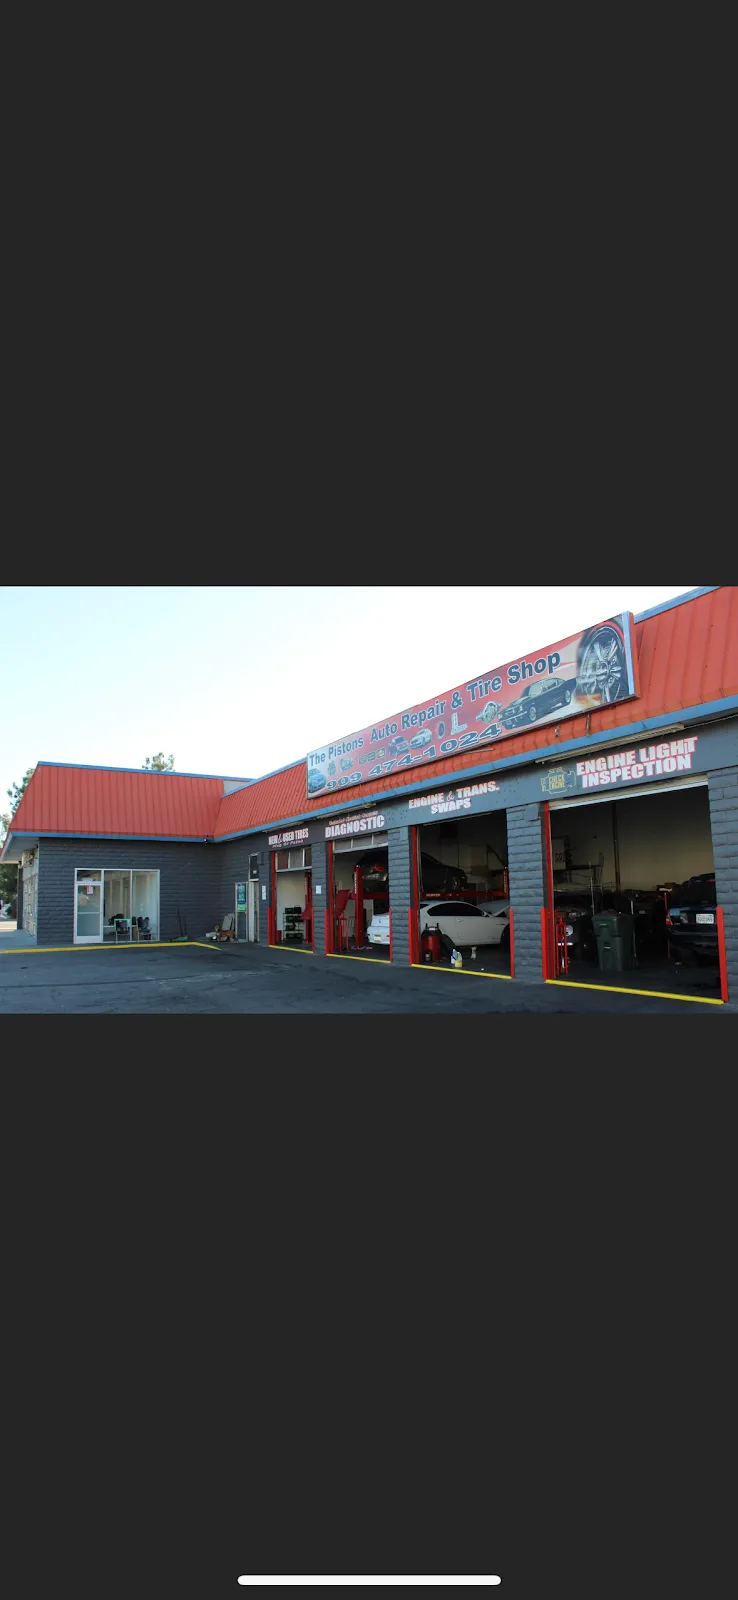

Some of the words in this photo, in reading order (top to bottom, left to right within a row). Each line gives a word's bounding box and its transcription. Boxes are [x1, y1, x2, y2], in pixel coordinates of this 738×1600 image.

[309, 752, 326, 767] The
[328, 736, 364, 760] Pistons
[369, 721, 398, 743] Auto
[401, 699, 446, 731] Repair
[450, 691, 463, 710] &
[466, 675, 503, 702] Tire
[507, 651, 561, 685] Shop
[326, 771, 362, 790] 909
[369, 722, 502, 776] 474-1024
[576, 750, 636, 776] ENGINE
[639, 736, 698, 763] LIGHT
[581, 753, 692, 788] INSPECTION
[408, 792, 444, 809] ENGINE
[446, 790, 455, 802] &
[456, 780, 500, 799] TRANS.
[430, 797, 472, 814] SWAPS
[282, 831, 295, 842] USED
[295, 827, 309, 840] TIRES
[325, 814, 385, 838] DIAGNOSTIC
